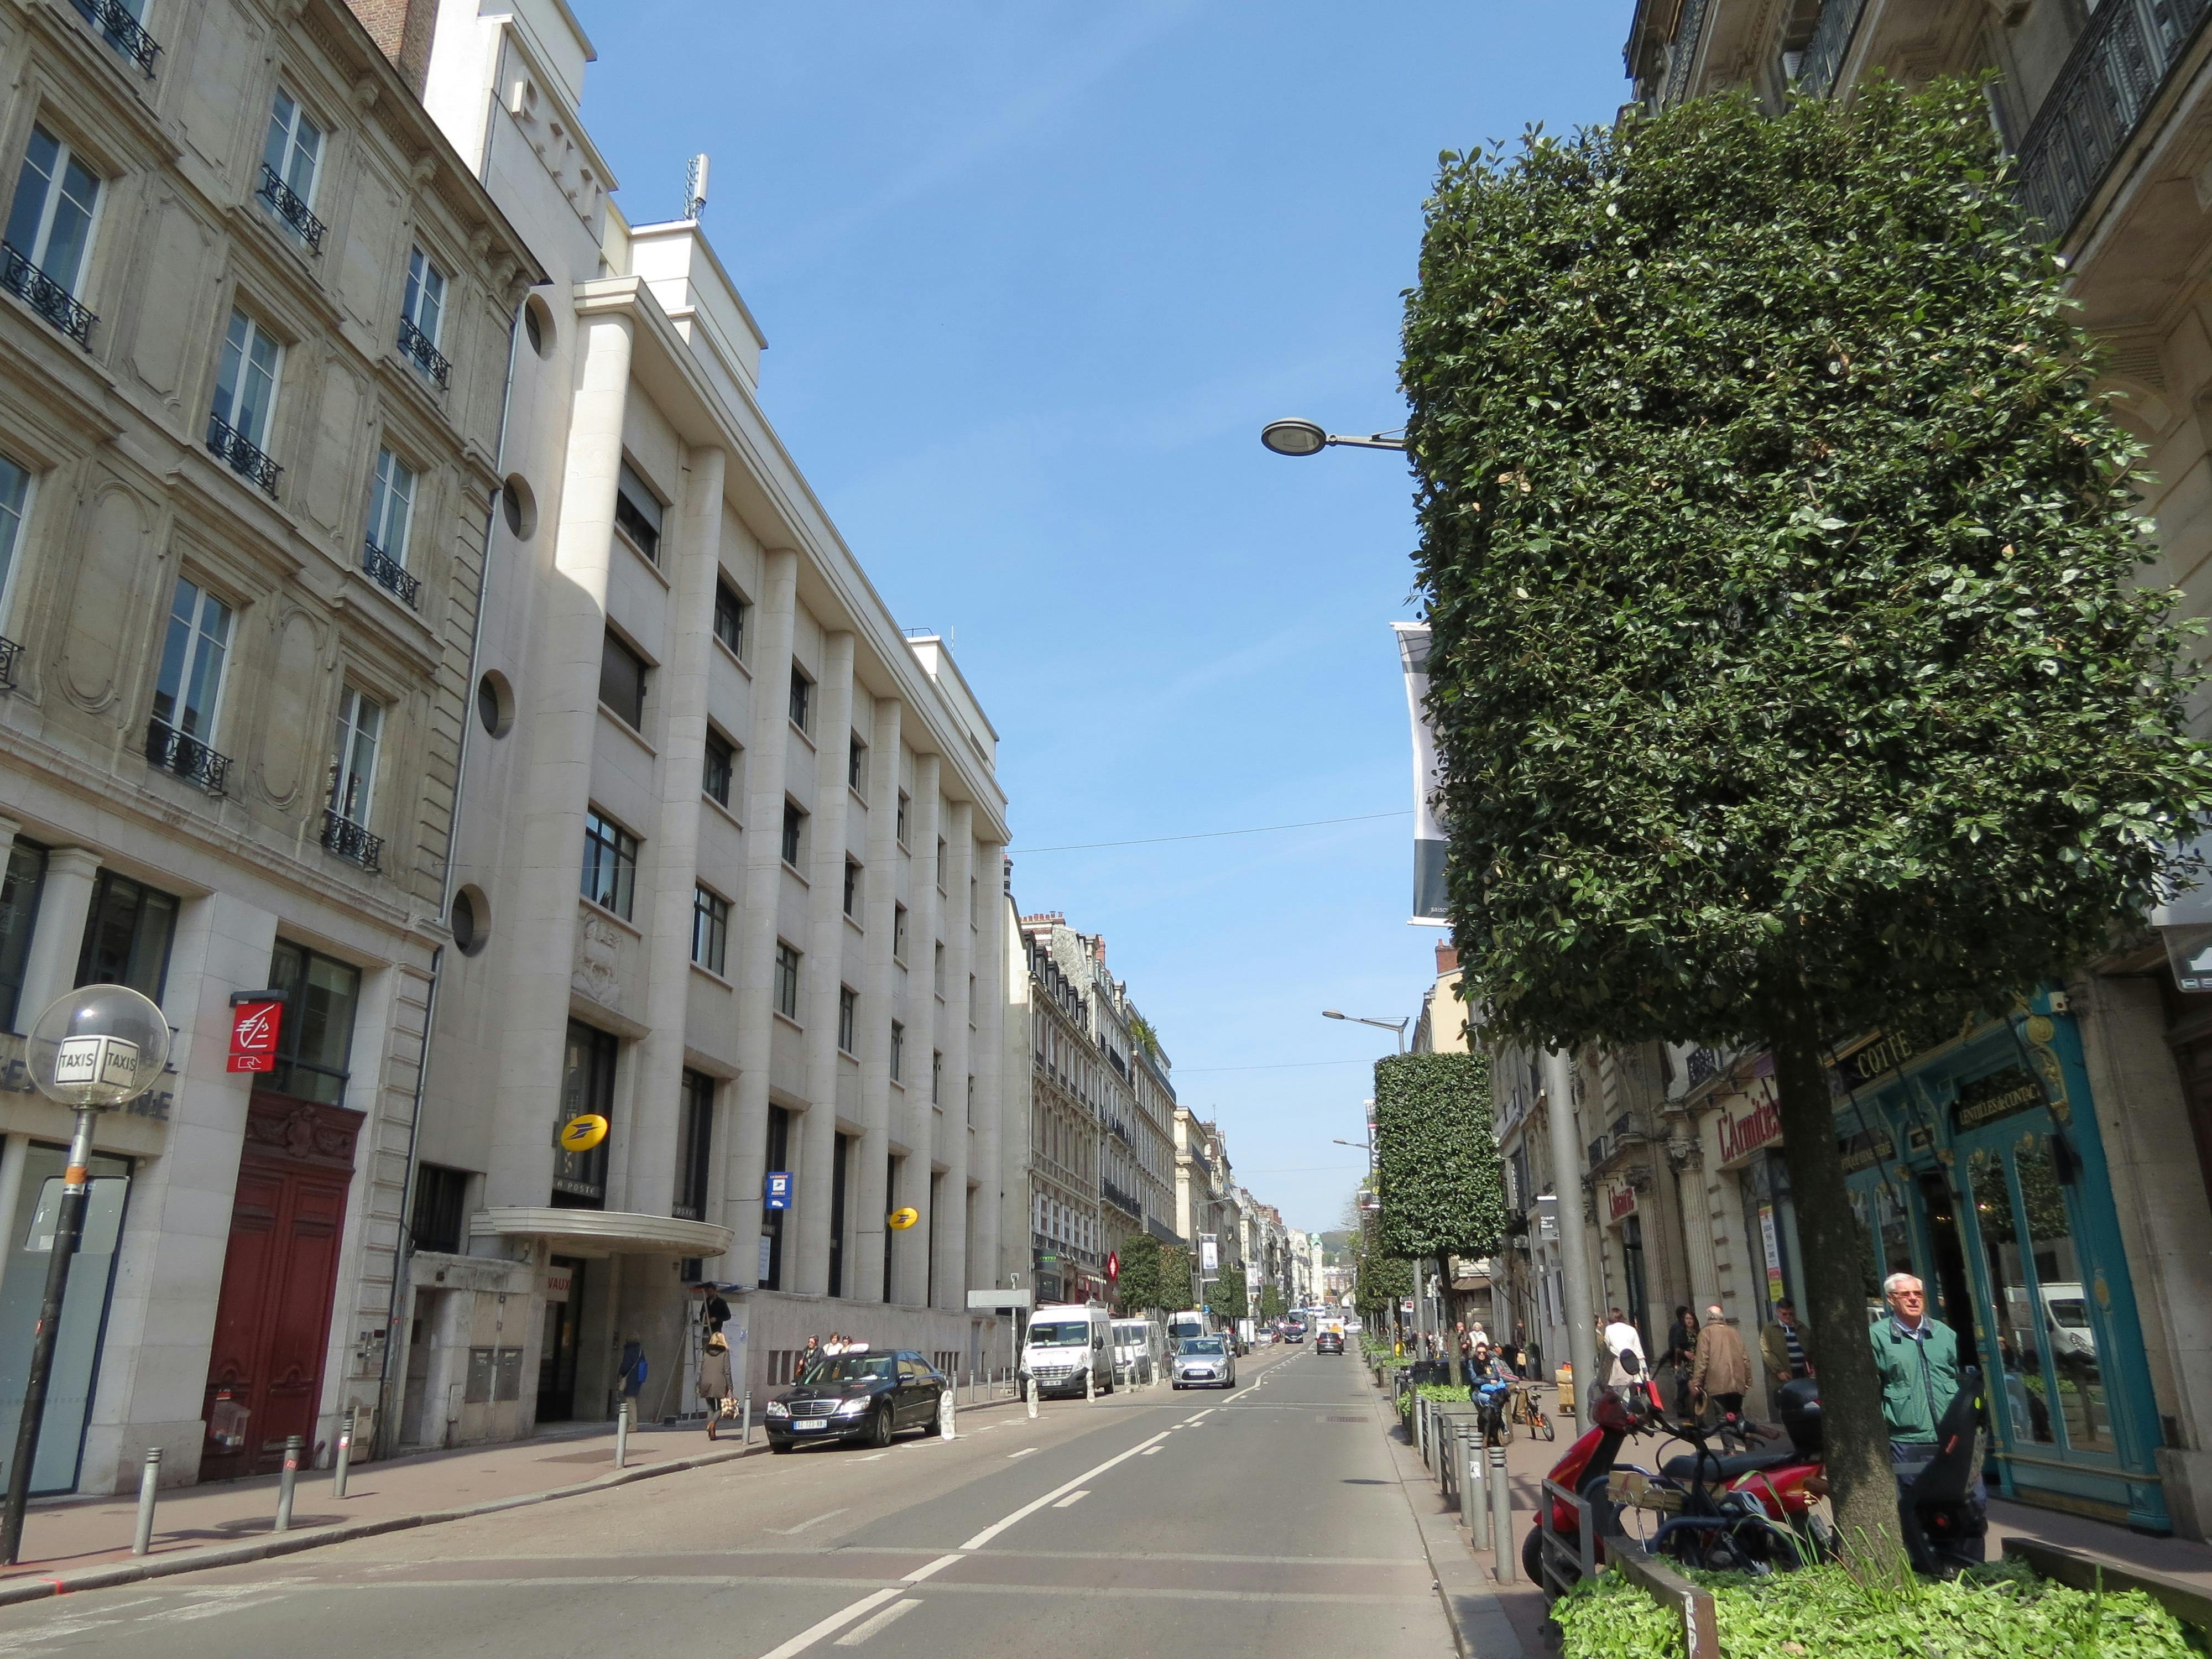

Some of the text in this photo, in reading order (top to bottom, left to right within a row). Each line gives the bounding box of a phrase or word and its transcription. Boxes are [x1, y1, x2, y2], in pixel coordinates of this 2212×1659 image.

[60, 1053, 95, 1068] TAXIS
[108, 1052, 136, 1072] TAXIS
[567, 1182, 596, 1194] POSTE
